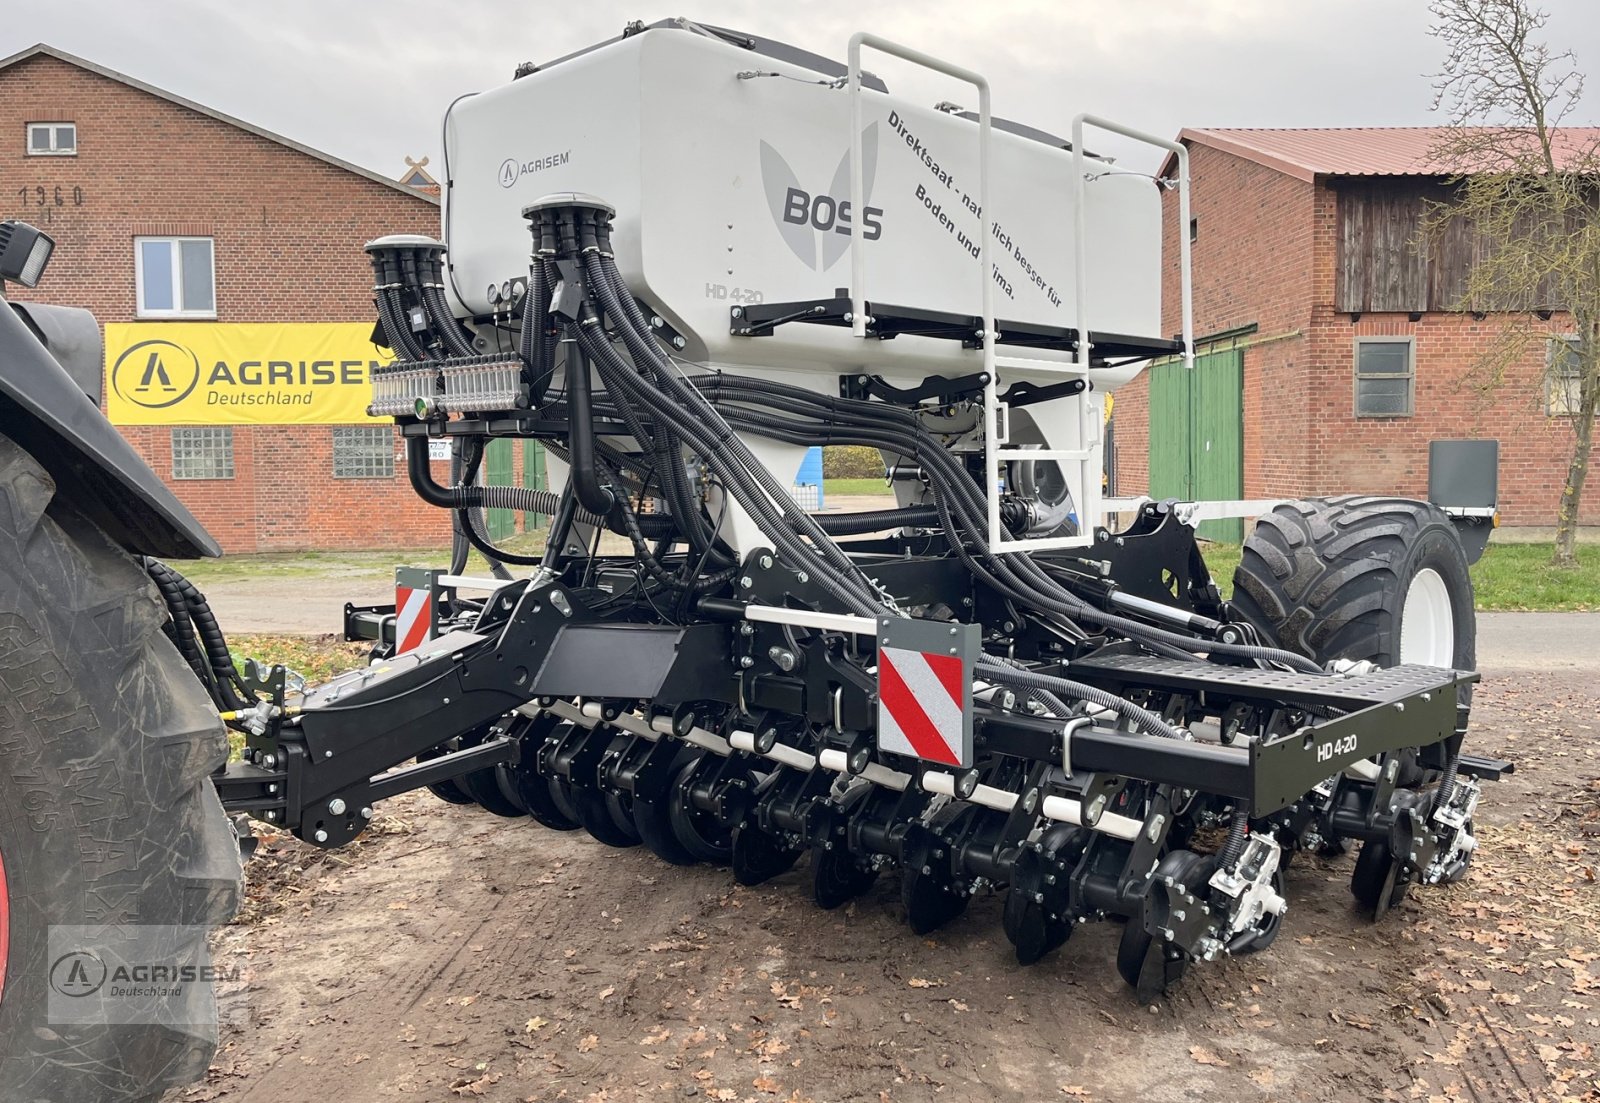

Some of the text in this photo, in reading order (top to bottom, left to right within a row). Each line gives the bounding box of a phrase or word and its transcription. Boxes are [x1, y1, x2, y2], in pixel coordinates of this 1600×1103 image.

[520, 152, 569, 176] AGRISEM
[18, 186, 82, 207] 1960
[888, 110, 953, 189] Direktsaat
[962, 193, 1013, 252] natlich
[1014, 247, 1047, 291] besser
[1047, 286, 1062, 308] für
[783, 187, 884, 241] BOSS
[915, 183, 955, 234] Boden
[957, 231, 981, 259] und
[705, 282, 764, 304] HD 4-20
[207, 391, 313, 405] Deutschland
[1317, 734, 1358, 763] HD 4-20
